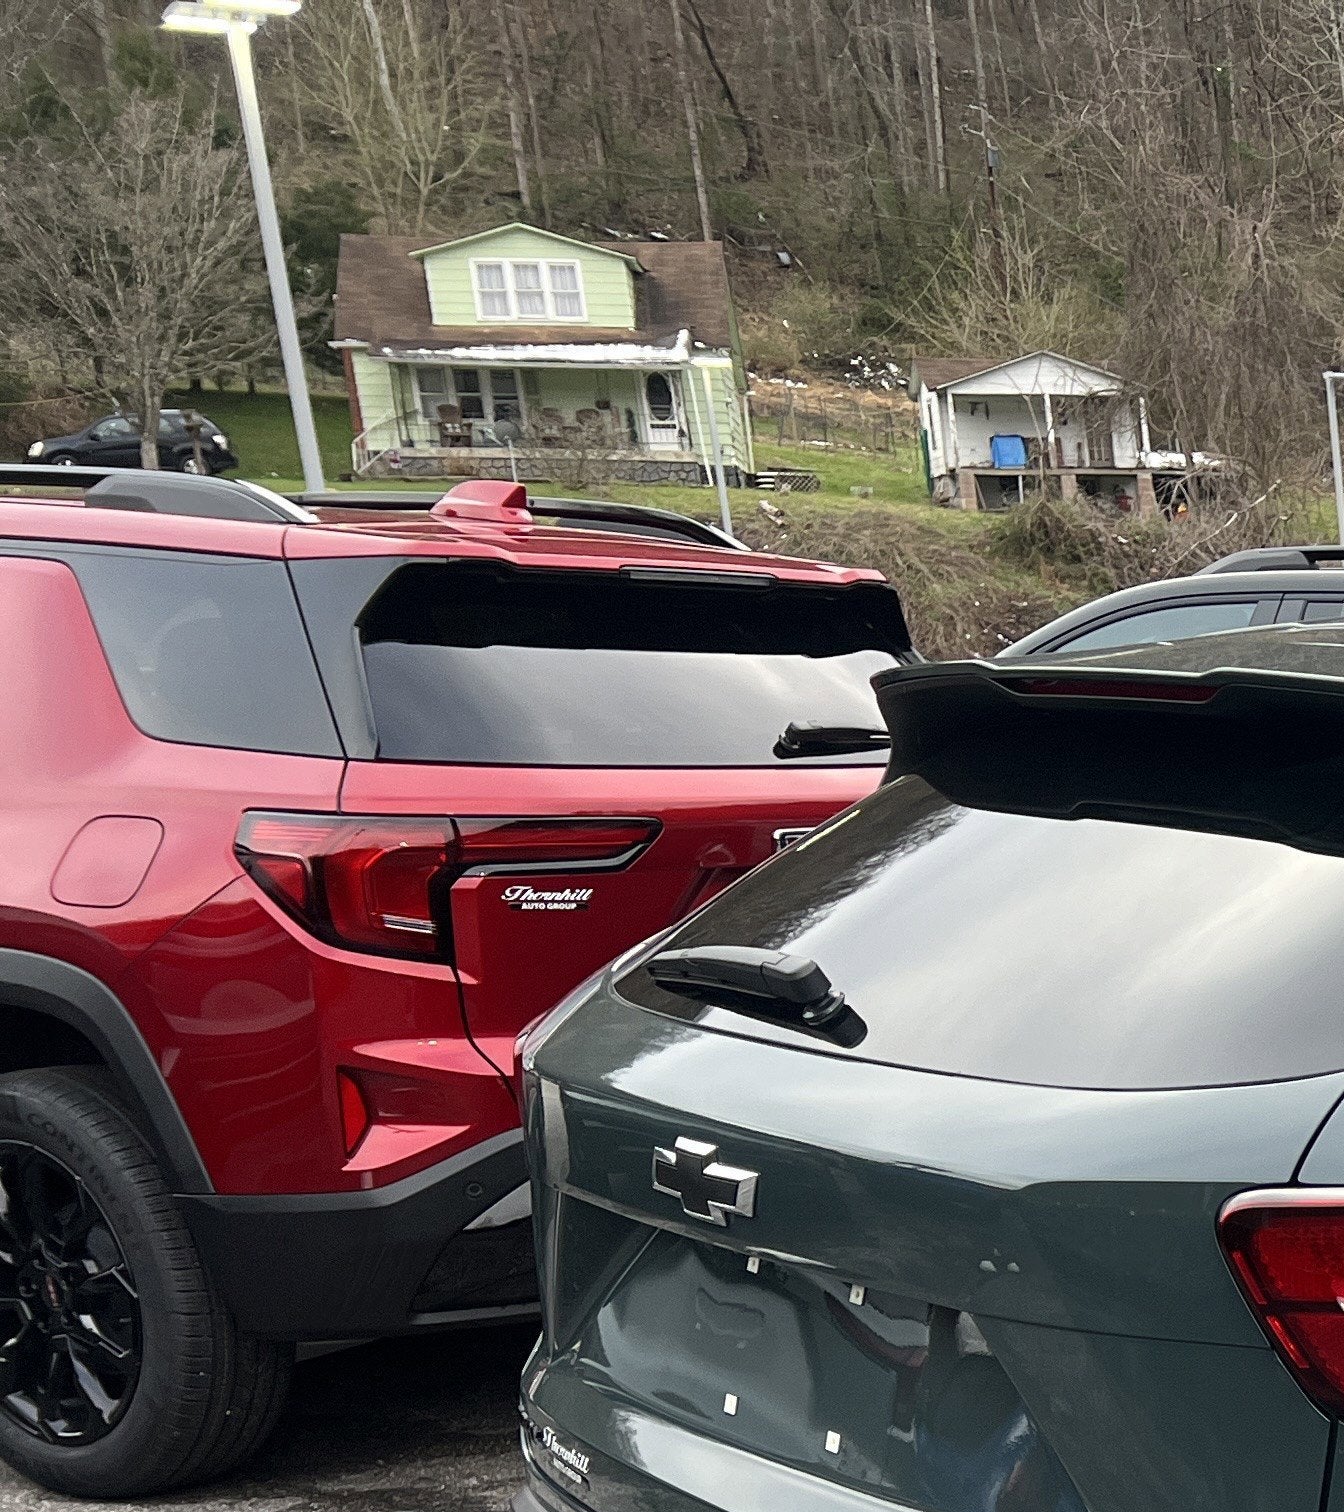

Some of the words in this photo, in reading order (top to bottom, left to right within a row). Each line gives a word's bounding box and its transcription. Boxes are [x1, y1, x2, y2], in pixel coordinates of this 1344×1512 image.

[501, 886, 594, 900] Thornhill
[521, 902, 546, 910] AUTO
[547, 902, 577, 910] GROUP
